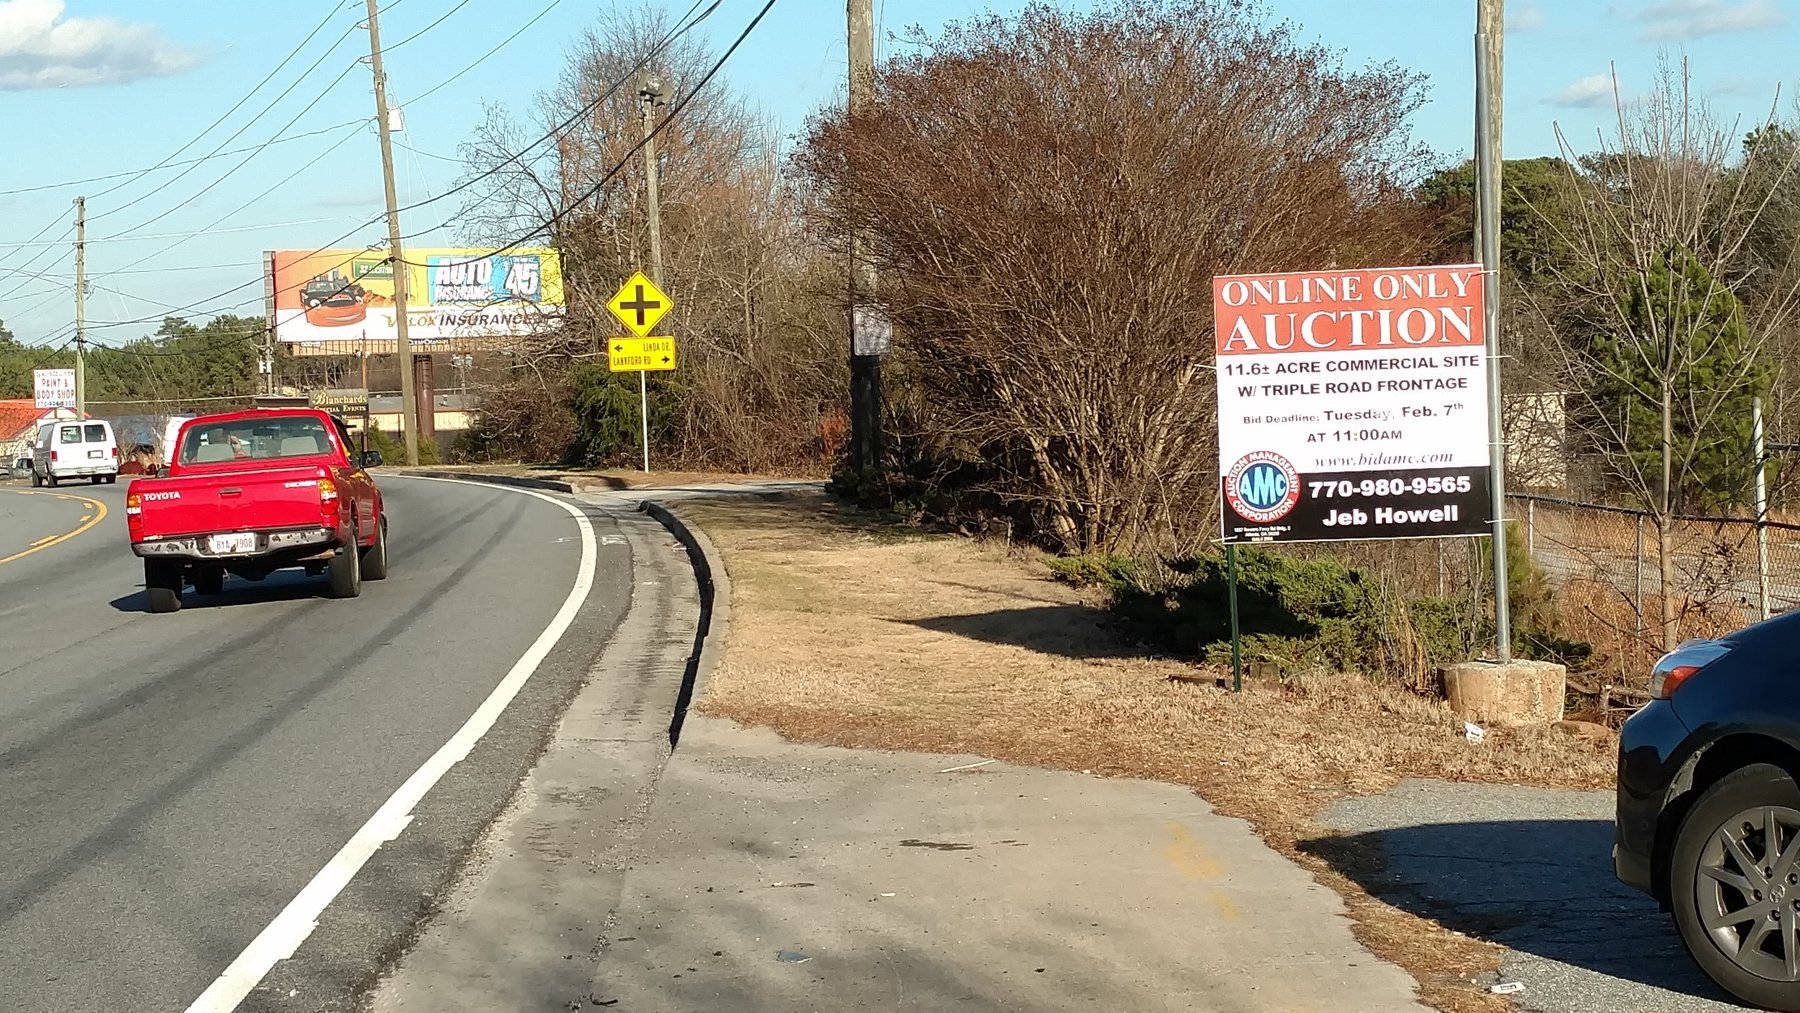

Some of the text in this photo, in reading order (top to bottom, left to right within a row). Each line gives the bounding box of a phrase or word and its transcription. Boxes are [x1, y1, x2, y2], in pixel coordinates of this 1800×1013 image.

[436, 258, 493, 285] AUTO
[1221, 271, 1474, 306] ONLINE ONLY
[1222, 306, 1475, 352] AUCTION
[642, 342, 660, 352] LINDA
[1225, 354, 1480, 377] 11.6± ACRE COMMERCIAL SITE
[57, 389, 74, 399] SHOP
[312, 391, 367, 405] Blanchards
[1238, 377, 1468, 398] W/ TRIPLE ROAD FRONTAGE
[1243, 415, 1262, 424] Bid
[1265, 413, 1320, 424] Deadline:
[1401, 405, 1438, 418] Feb.
[1443, 403, 1464, 417] 7th
[1307, 429, 1403, 443] AT 11:00AM
[1315, 452, 1455, 467] www.bidamc.com
[1227, 451, 1298, 497] AUCTION MANAGEMENT
[143, 490, 181, 502] TOYOTA
[1240, 466, 1287, 506] AMC
[1308, 475, 1472, 499] 770-980-9565
[1232, 498, 1295, 521] CORPORATION
[1322, 504, 1460, 528] Jeb Howell
